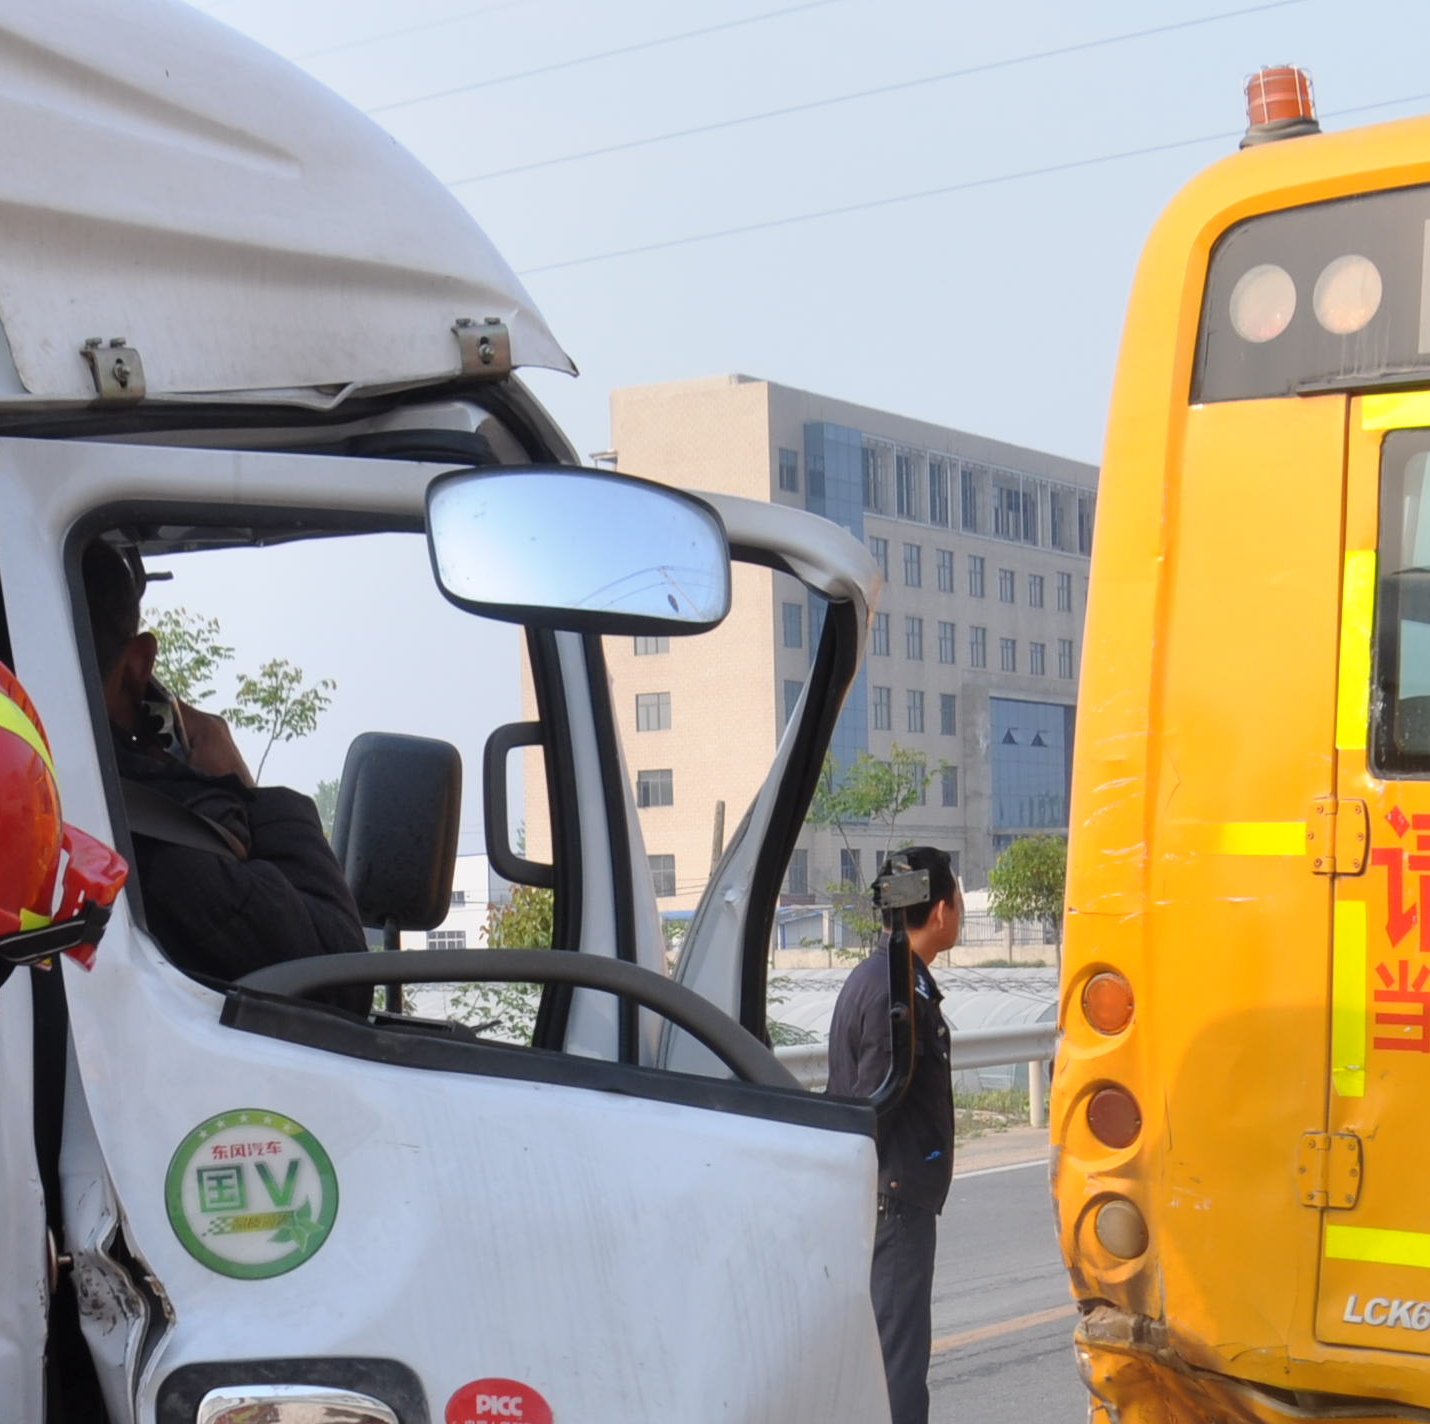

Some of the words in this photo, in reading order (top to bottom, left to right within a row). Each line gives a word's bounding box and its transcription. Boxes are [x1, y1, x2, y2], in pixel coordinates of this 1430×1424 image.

[212, 1141, 282, 1160] 东风汽车
[476, 1393, 523, 1417] PICC
